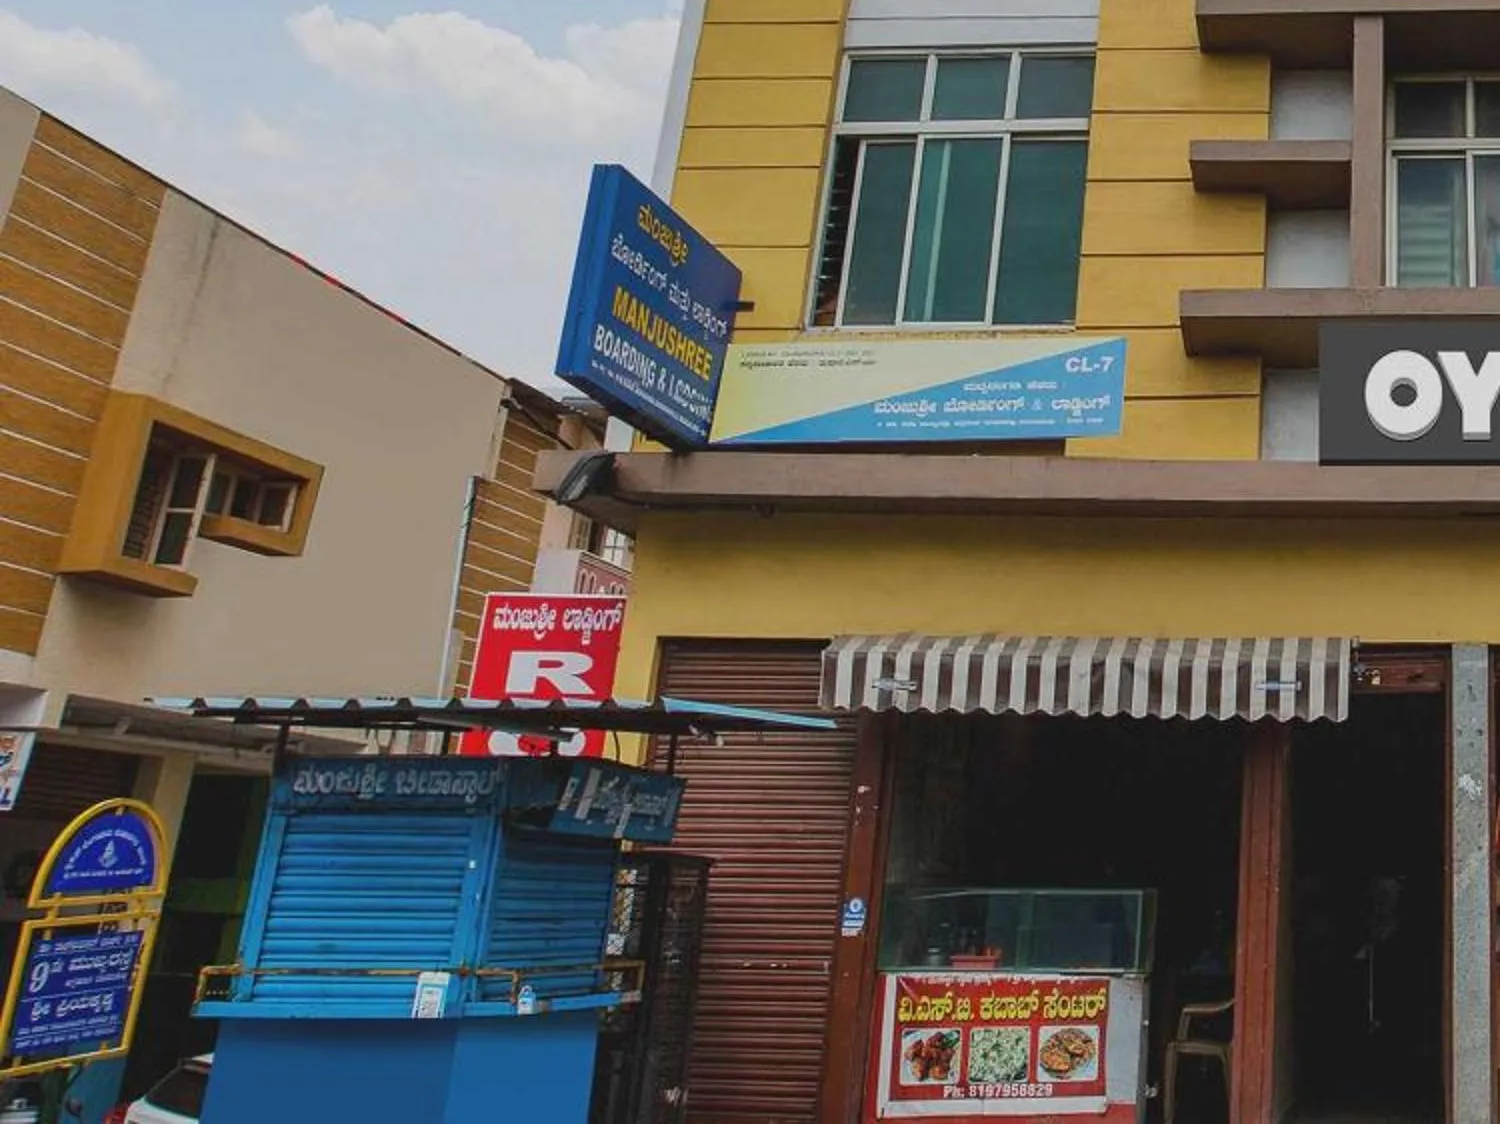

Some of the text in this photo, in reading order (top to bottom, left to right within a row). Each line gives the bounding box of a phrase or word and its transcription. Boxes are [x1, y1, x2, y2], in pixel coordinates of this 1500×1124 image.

[594, 323, 657, 388] BOARDING
[612, 285, 713, 381] MANJUSHREE
[1065, 356, 1115, 373] CL-7
[506, 651, 595, 695] R
